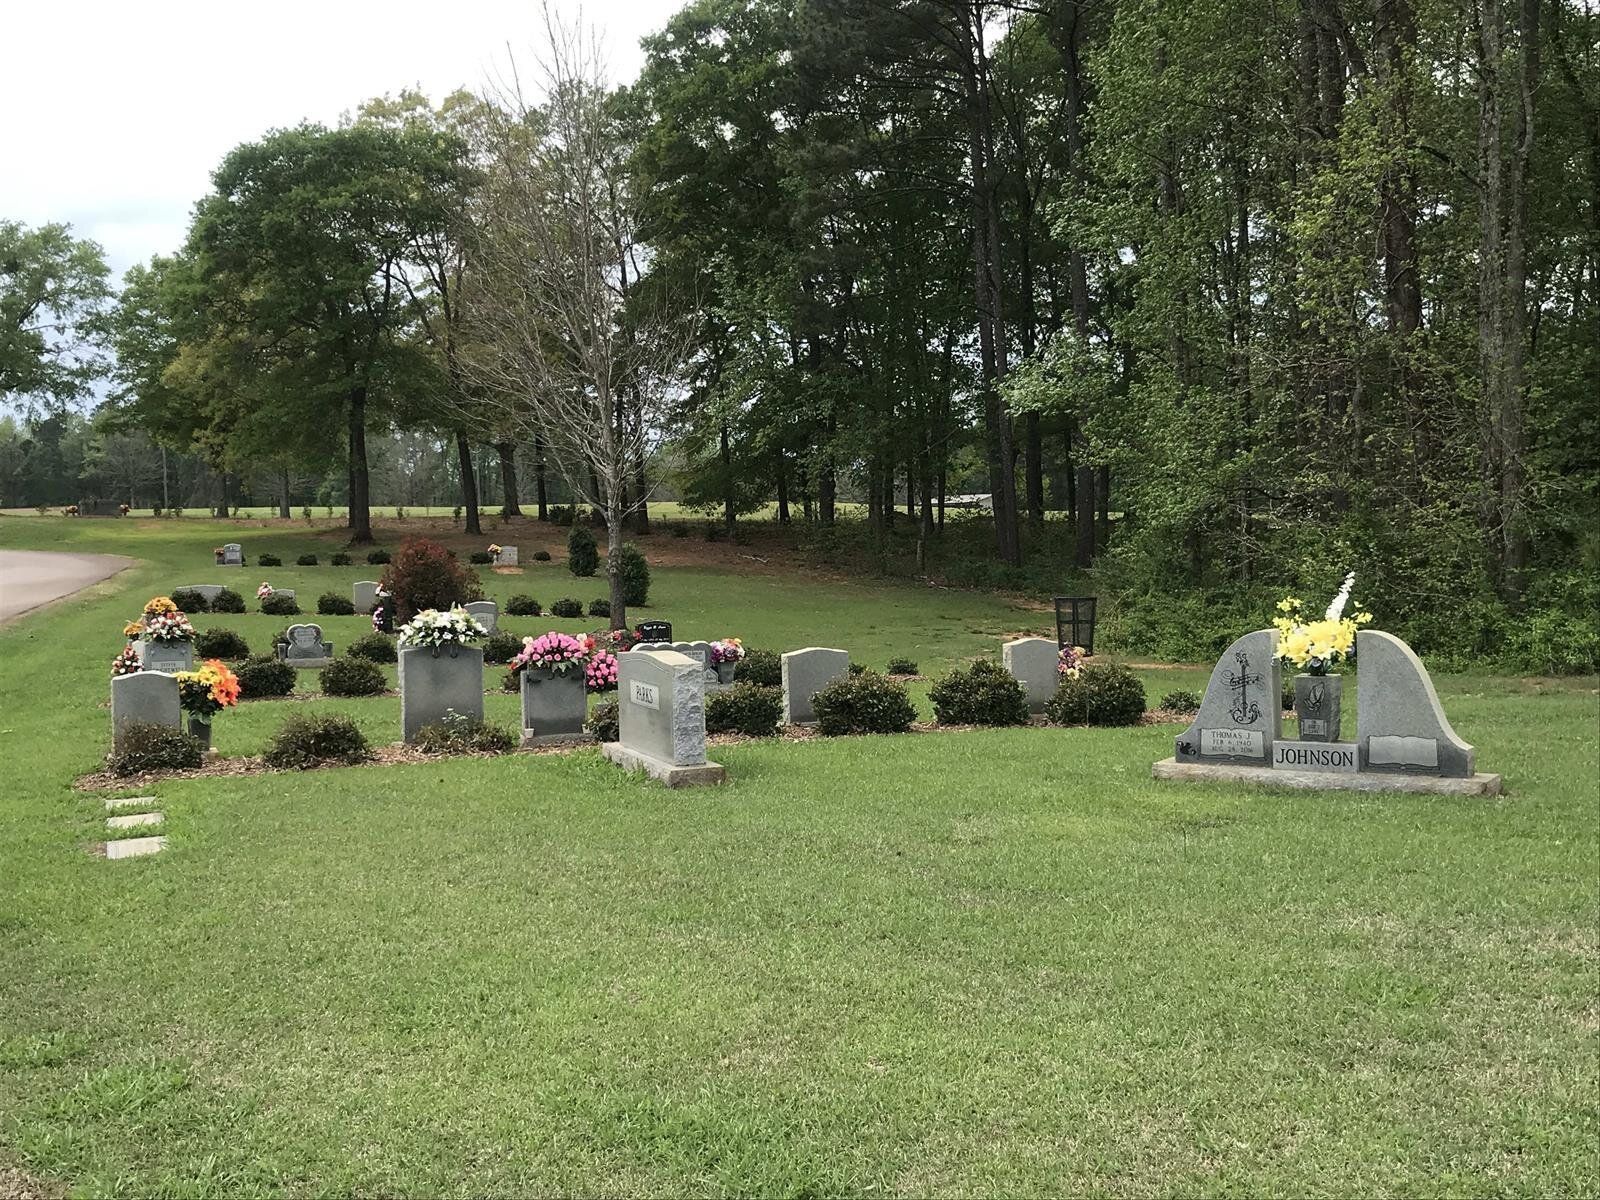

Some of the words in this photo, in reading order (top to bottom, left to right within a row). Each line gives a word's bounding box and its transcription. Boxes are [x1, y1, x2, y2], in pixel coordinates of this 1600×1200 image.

[635, 684, 654, 704] PARKS
[1211, 731, 1243, 739] THOMAS
[1275, 748, 1354, 767] JOHNSON
